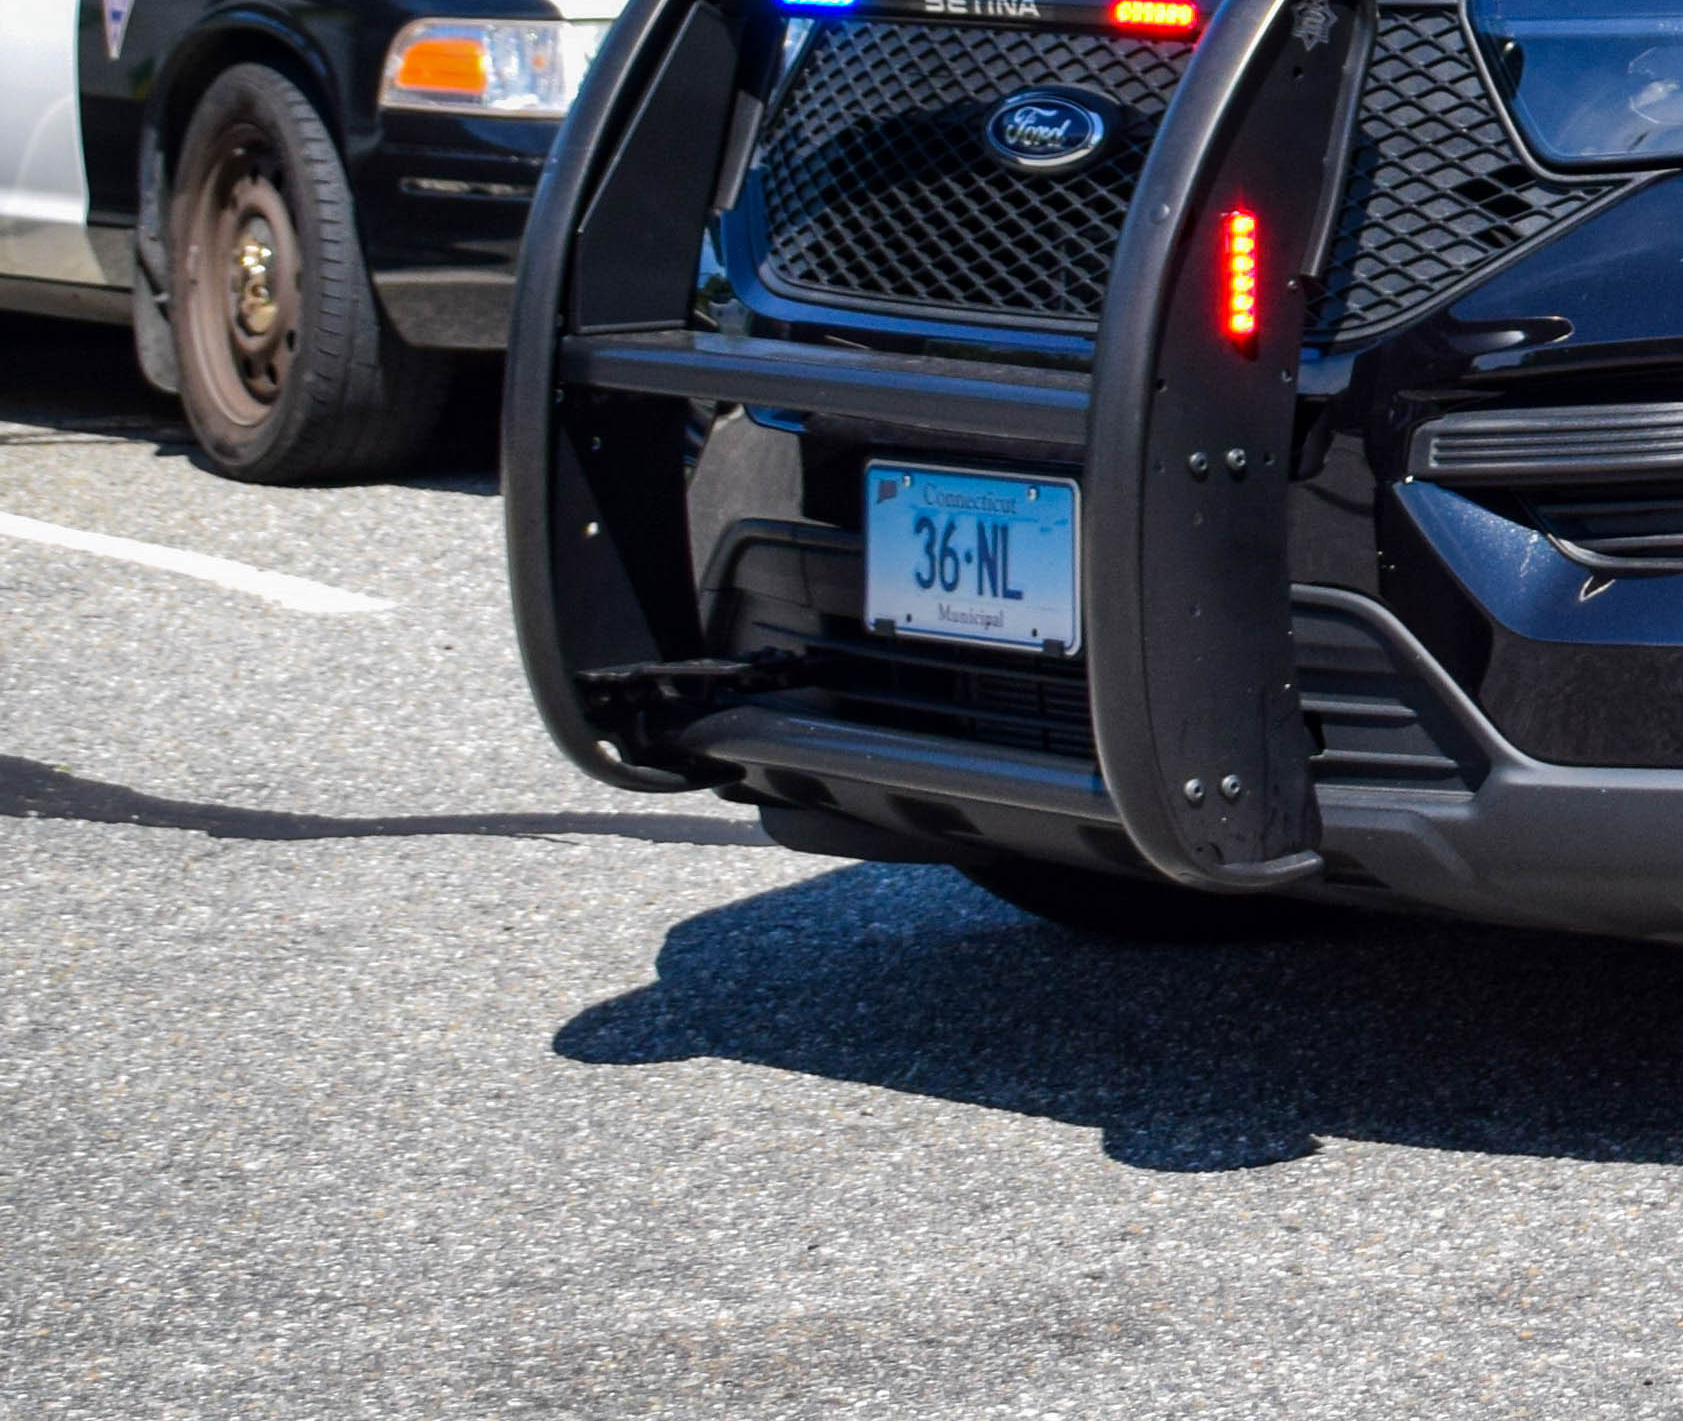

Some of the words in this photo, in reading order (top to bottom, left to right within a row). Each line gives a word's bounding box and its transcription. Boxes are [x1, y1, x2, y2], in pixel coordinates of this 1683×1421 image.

[1005, 106, 1072, 147] Ford
[922, 483, 1017, 515] Connecticut
[938, 602, 1004, 629] Municipal
